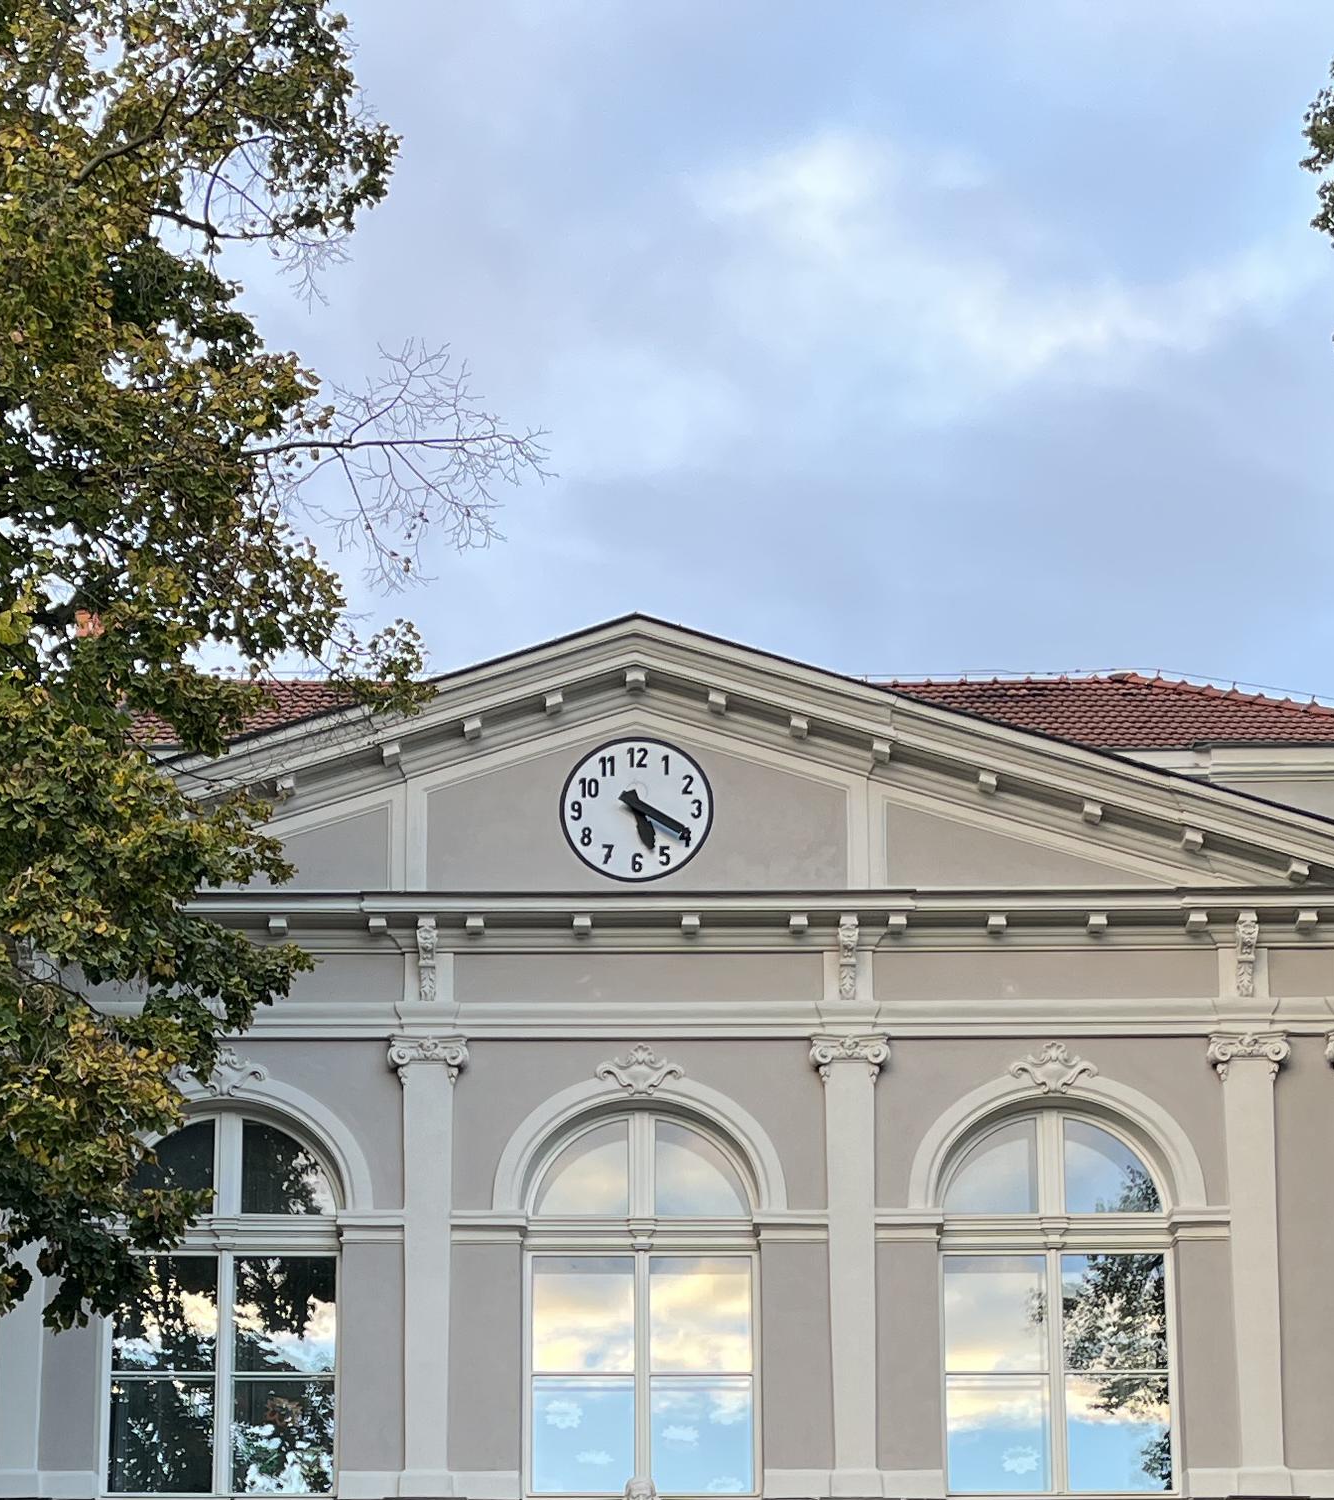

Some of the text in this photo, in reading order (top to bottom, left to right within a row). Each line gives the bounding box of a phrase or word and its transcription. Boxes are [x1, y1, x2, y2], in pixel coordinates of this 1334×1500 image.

[599, 756, 615, 777] 11
[627, 748, 648, 768] 12
[661, 755, 670, 775] 1
[579, 778, 599, 798] 10
[682, 775, 694, 795] 2
[570, 801, 582, 820] 9
[691, 799, 702, 819] 3
[580, 827, 592, 846] 8
[679, 827, 691, 847] 4
[602, 844, 614, 864] 7
[631, 853, 642, 872] 6
[659, 846, 670, 866] 5
